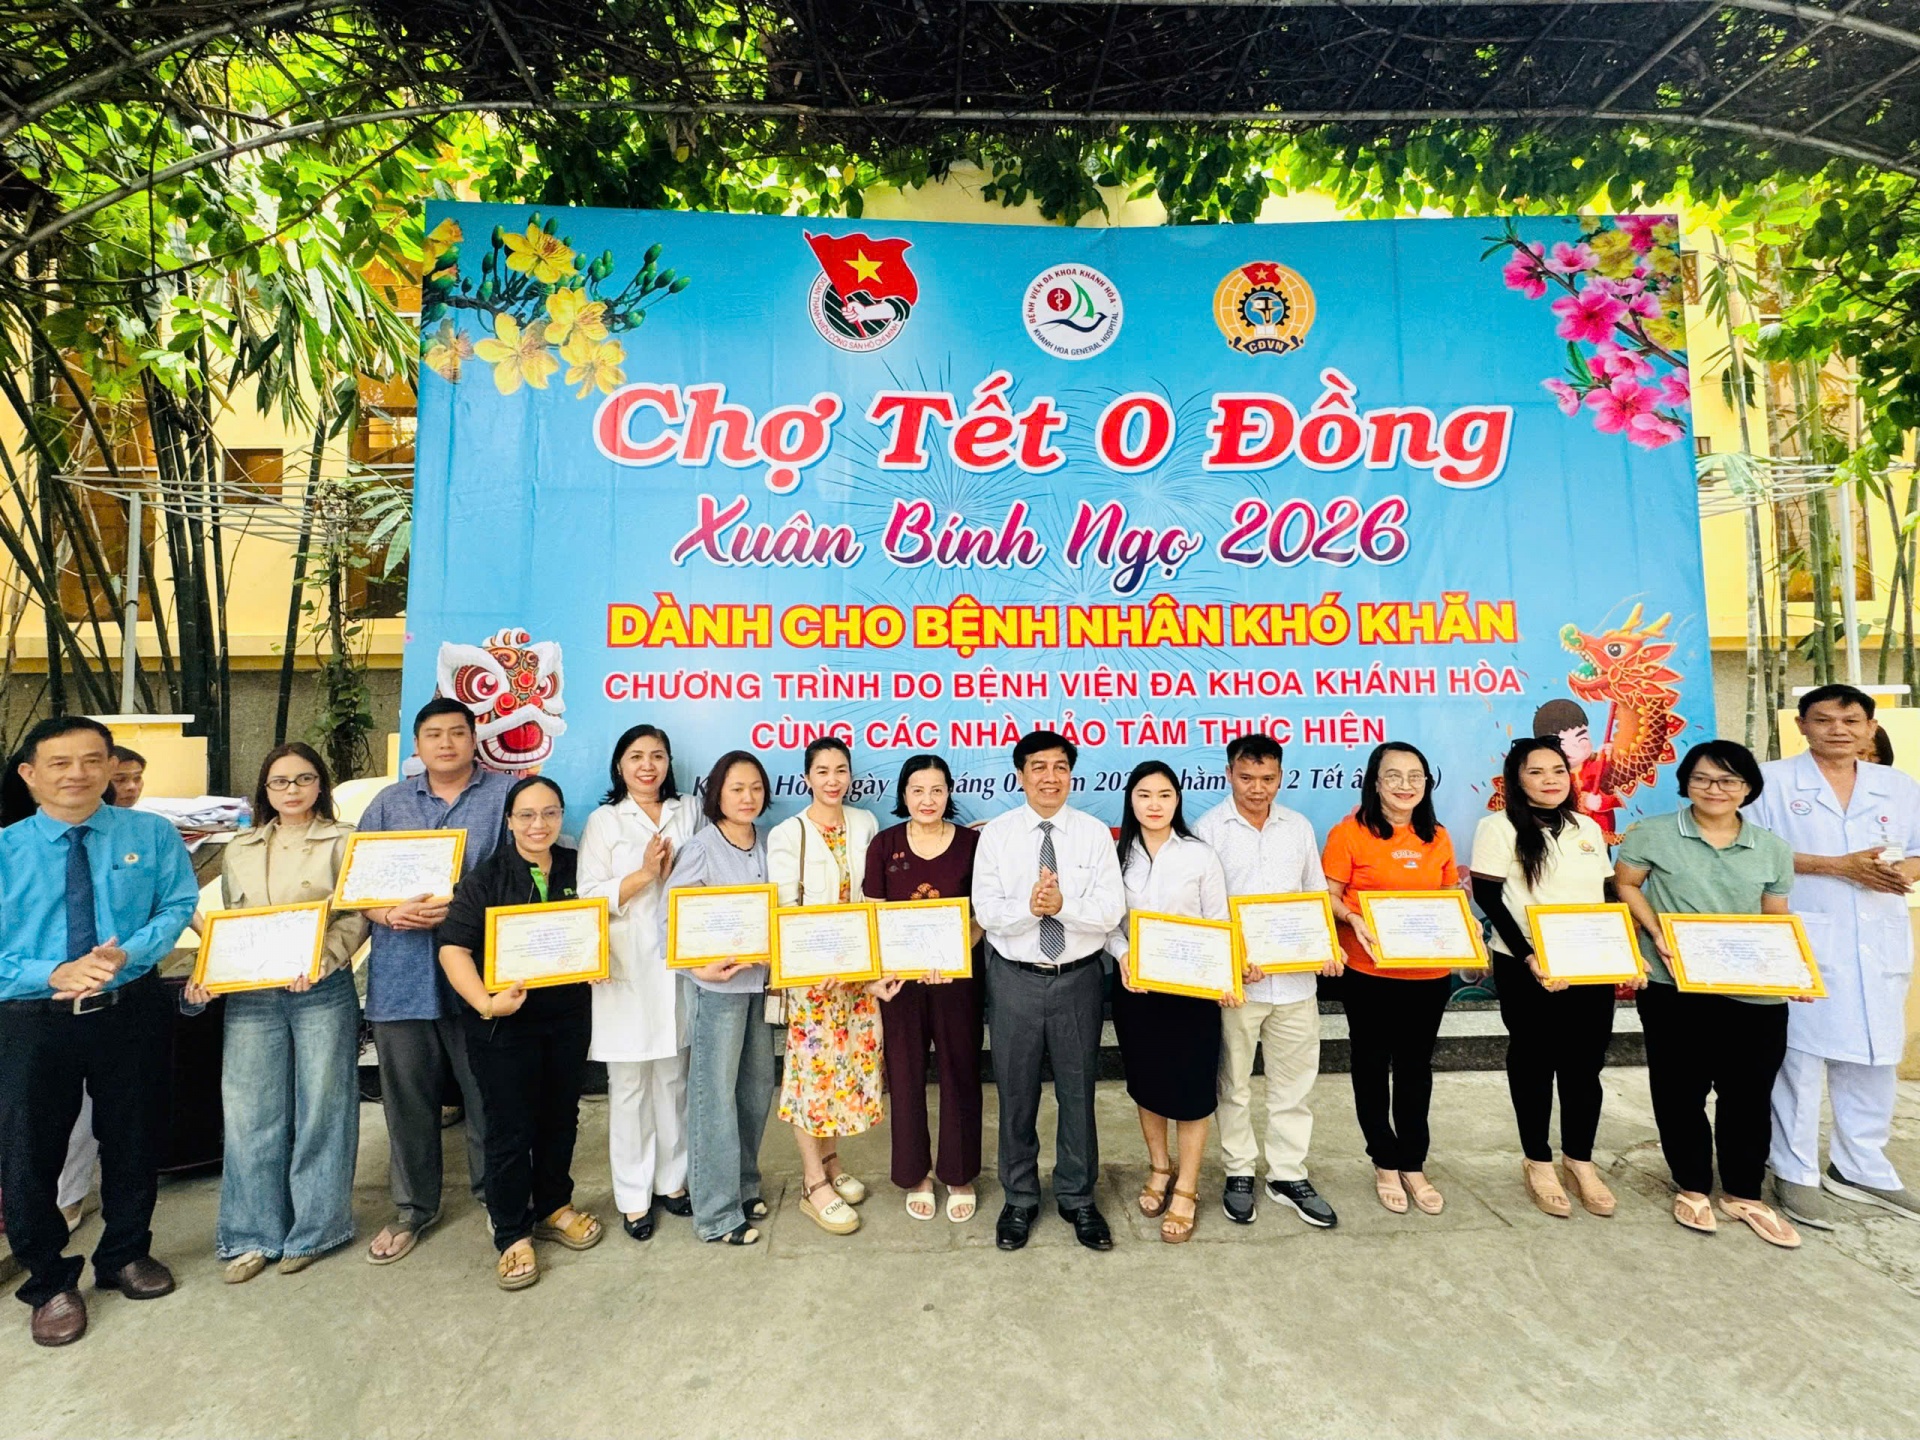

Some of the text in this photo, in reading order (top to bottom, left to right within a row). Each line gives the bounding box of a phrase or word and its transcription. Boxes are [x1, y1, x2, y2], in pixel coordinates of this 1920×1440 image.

[1054, 268, 1077, 278] KHOA
[1033, 312, 1119, 356] KHANH HOA GENERAL HOSPITAL
[1248, 340, 1284, 352] CĐVN
[598, 387, 838, 489] Chợ
[870, 375, 1062, 469] Tết
[1208, 372, 1509, 483] Đồng
[674, 497, 1407, 593] Xuân Bính Ngọ 2026
[607, 591, 1518, 659] DÀNH CHO BỆNH NHÂN KHÓ KHĂN
[604, 661, 1521, 704] CHƯƠNG TRÌNH DO BỆNH VIỆN ĐA KHOA KHÁNH HÒA
[752, 716, 853, 749] CÙNG
[866, 718, 939, 748] CÁC
[951, 715, 1021, 746] NHÀ
[1116, 713, 1186, 745] TÂM
[1305, 712, 1384, 749] HIỆN
[775, 774, 813, 796] Hò
[844, 773, 890, 802] gày
[950, 771, 996, 800] áng
[1179, 765, 1226, 790] hằm
[1310, 763, 1344, 789] Tết
